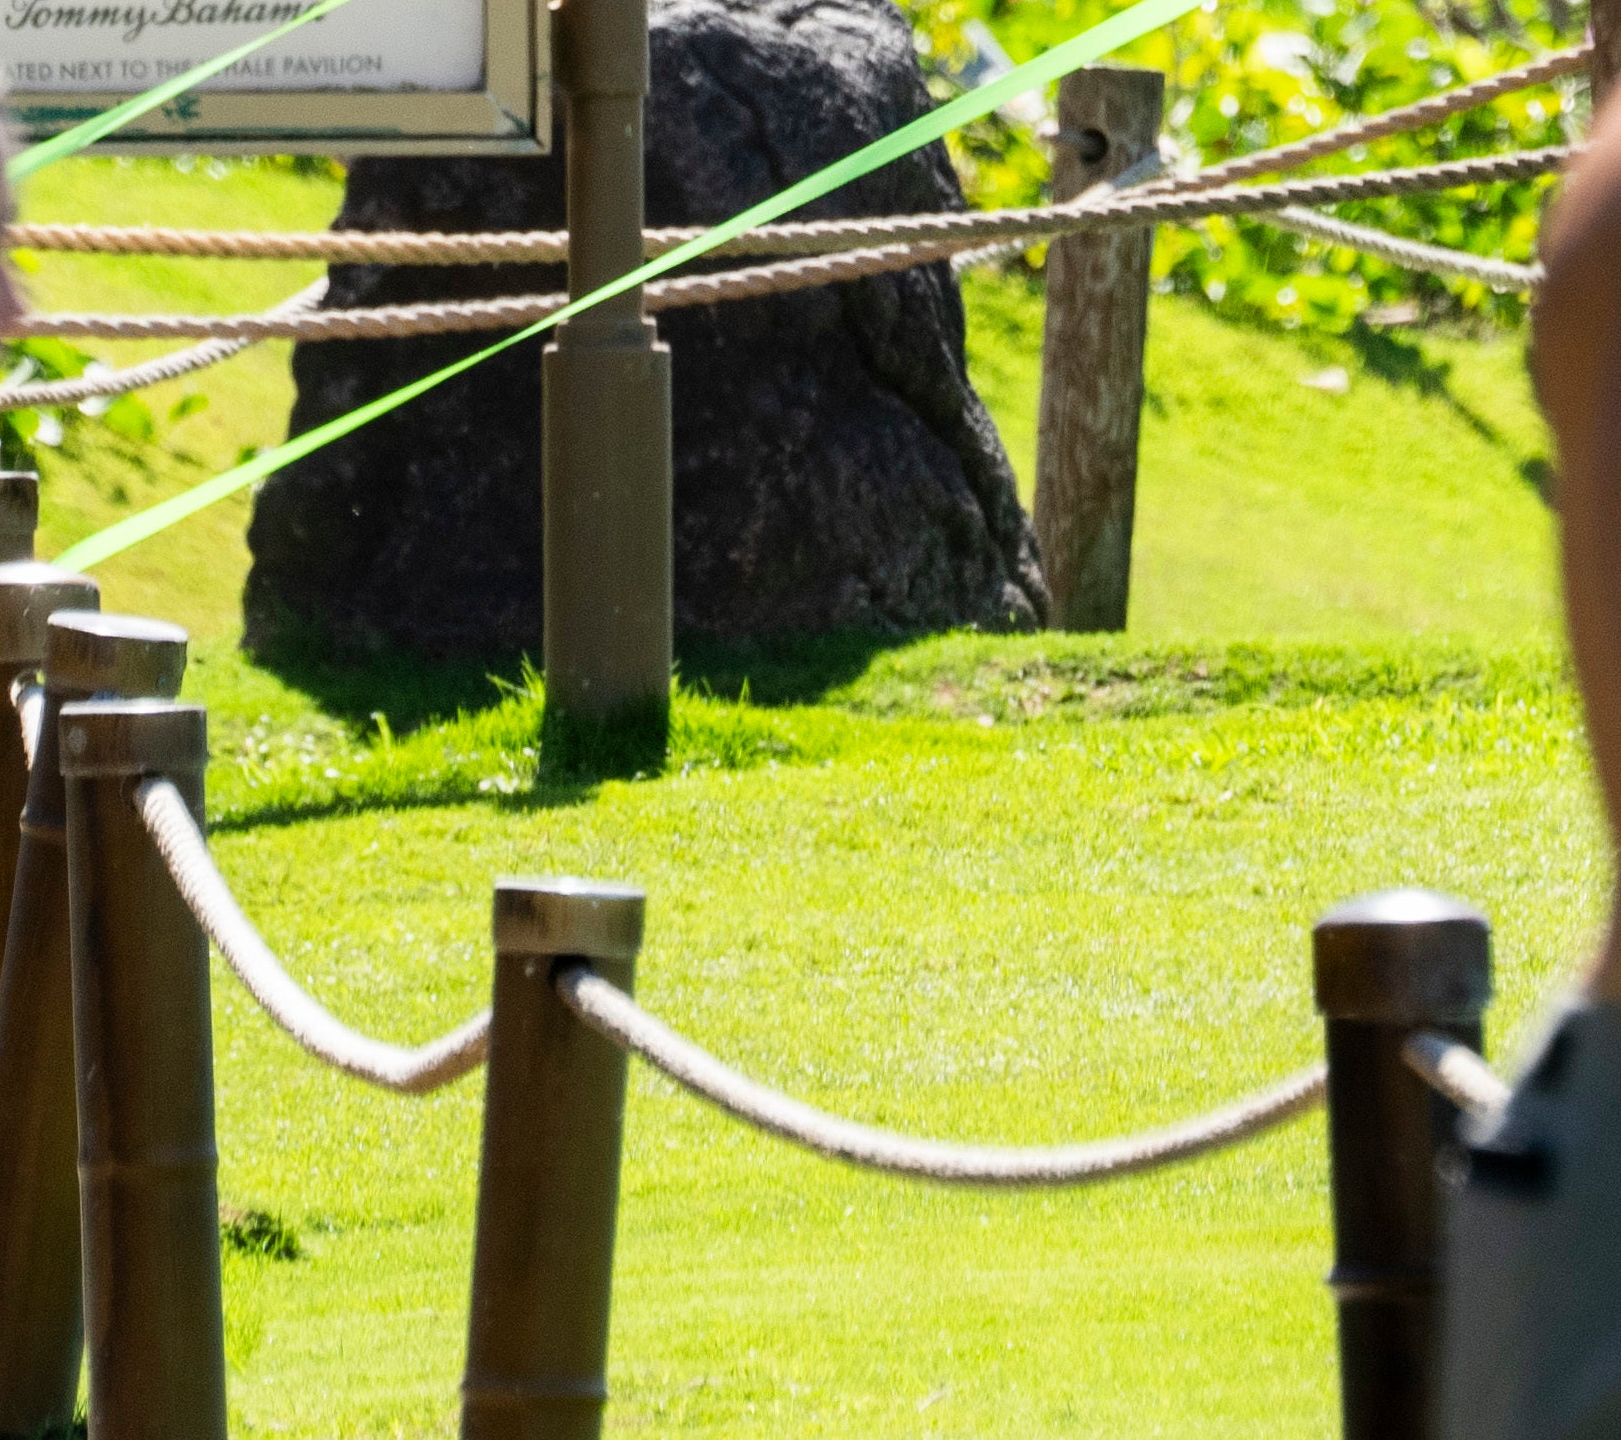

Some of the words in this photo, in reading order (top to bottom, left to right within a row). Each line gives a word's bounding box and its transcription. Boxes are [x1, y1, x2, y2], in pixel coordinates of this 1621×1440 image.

[59, 60, 112, 81] NEXT
[122, 60, 149, 81] TO
[282, 53, 382, 77] PAVILION
